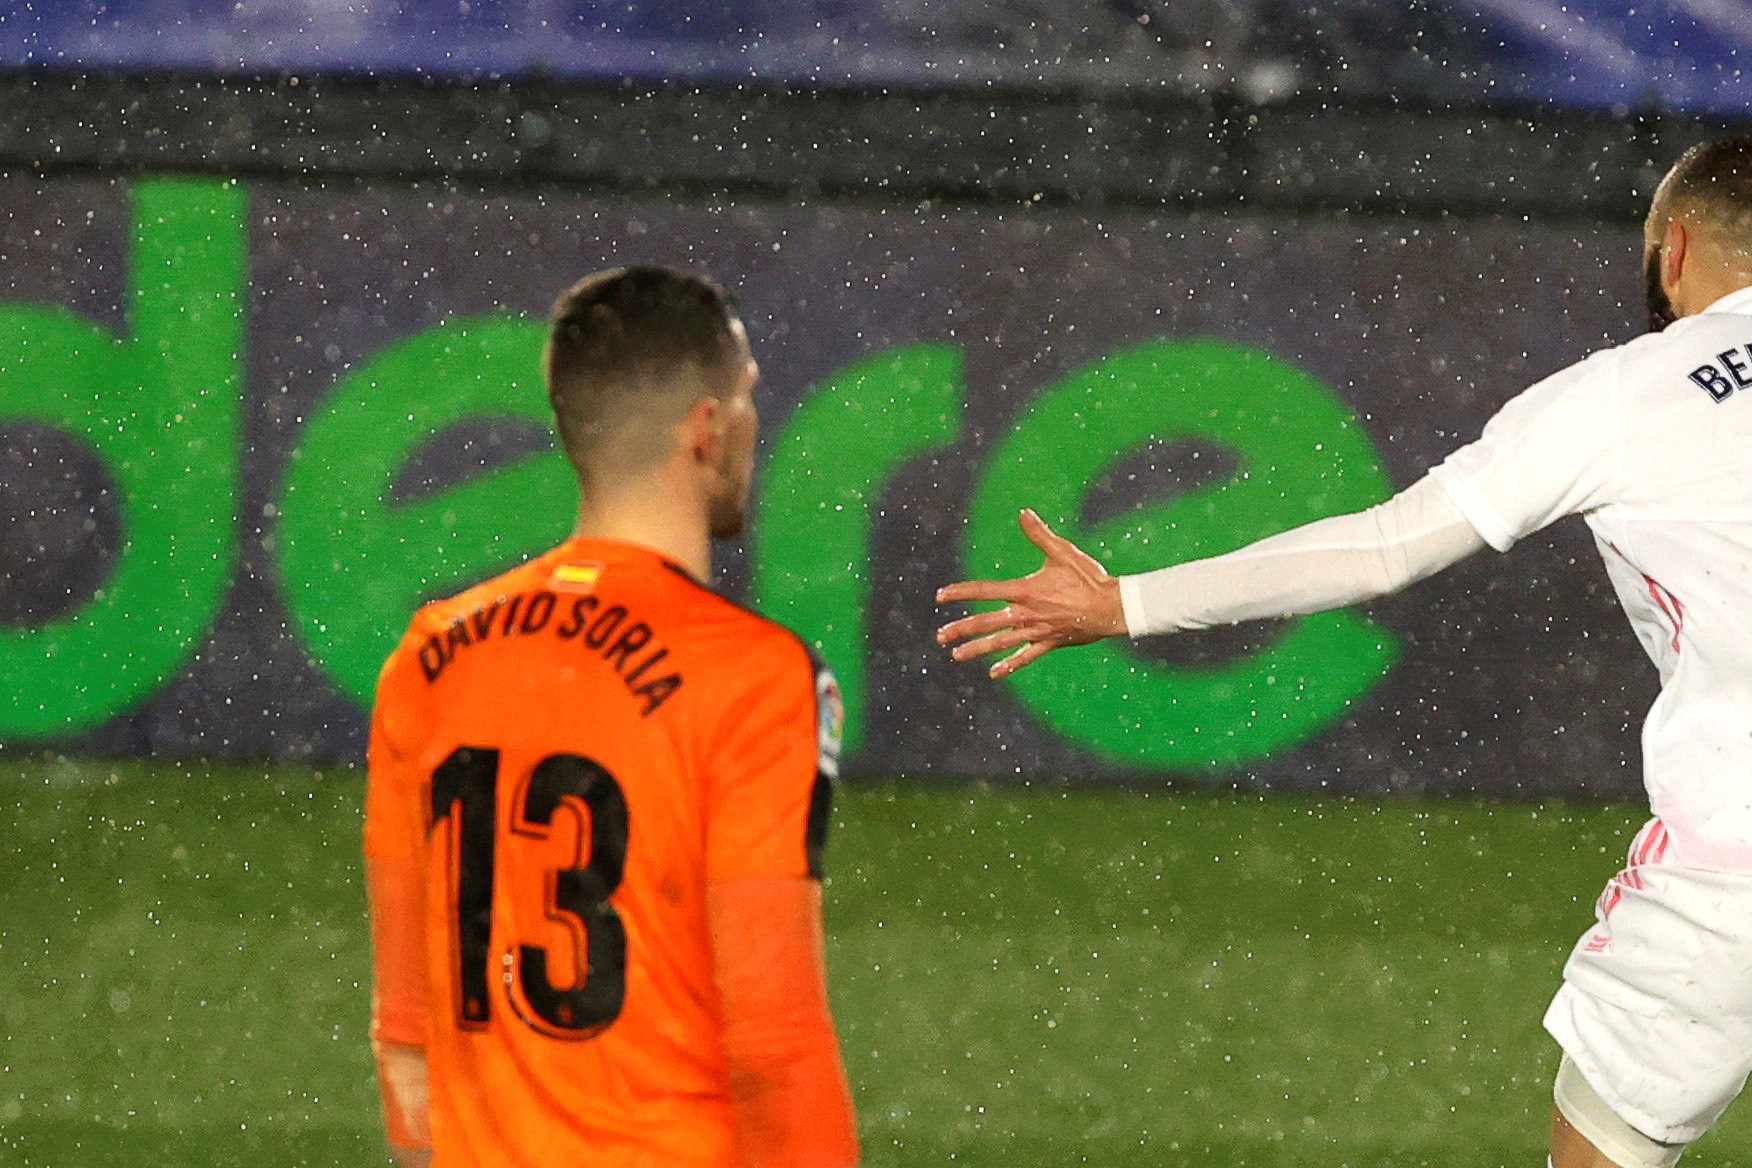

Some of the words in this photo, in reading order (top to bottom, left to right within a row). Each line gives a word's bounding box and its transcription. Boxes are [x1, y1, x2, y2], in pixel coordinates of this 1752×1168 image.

[419, 590, 557, 684] DAVID
[556, 594, 683, 717] SORIA
[422, 745, 631, 1042] 13
